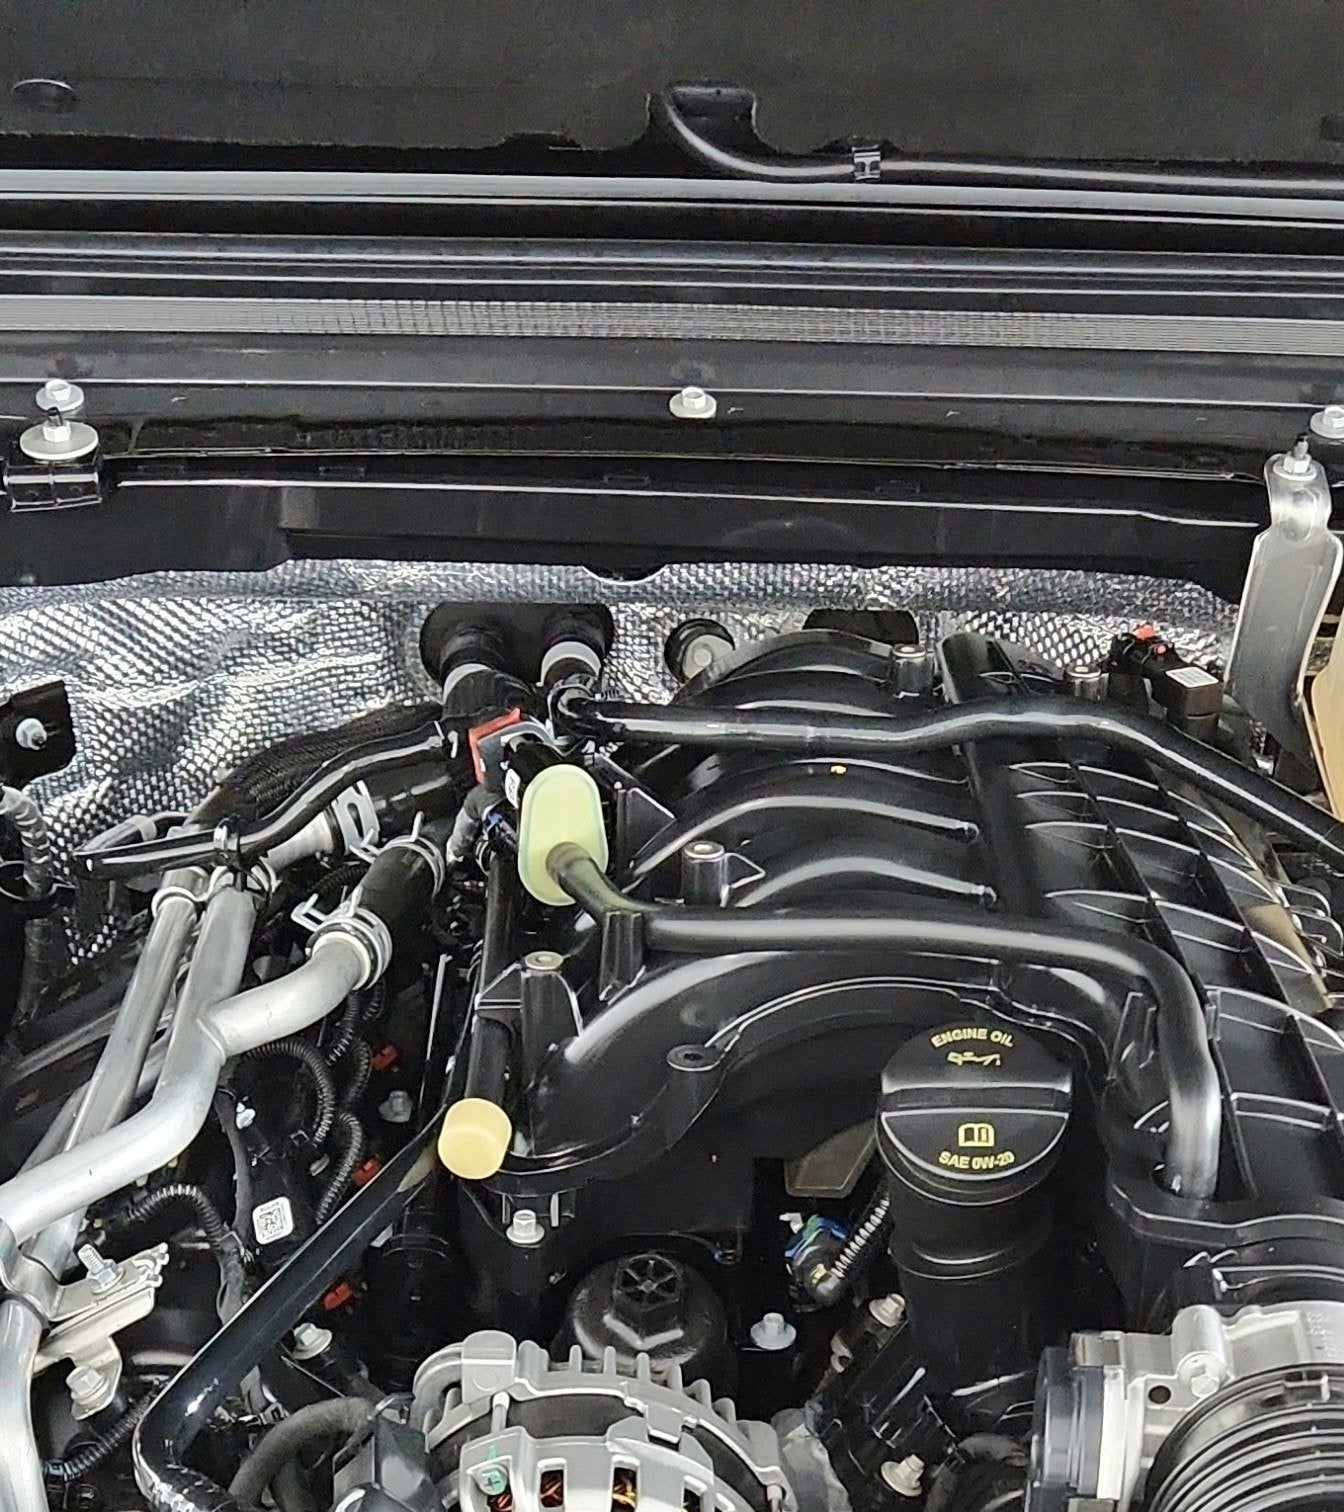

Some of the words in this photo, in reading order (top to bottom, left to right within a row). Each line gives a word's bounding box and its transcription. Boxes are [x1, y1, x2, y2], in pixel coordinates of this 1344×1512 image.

[930, 1027, 988, 1048] ENGINE
[989, 1030, 1014, 1048] OIL
[938, 1151, 970, 1169] SAE
[971, 1151, 1015, 1169] 0W-20
